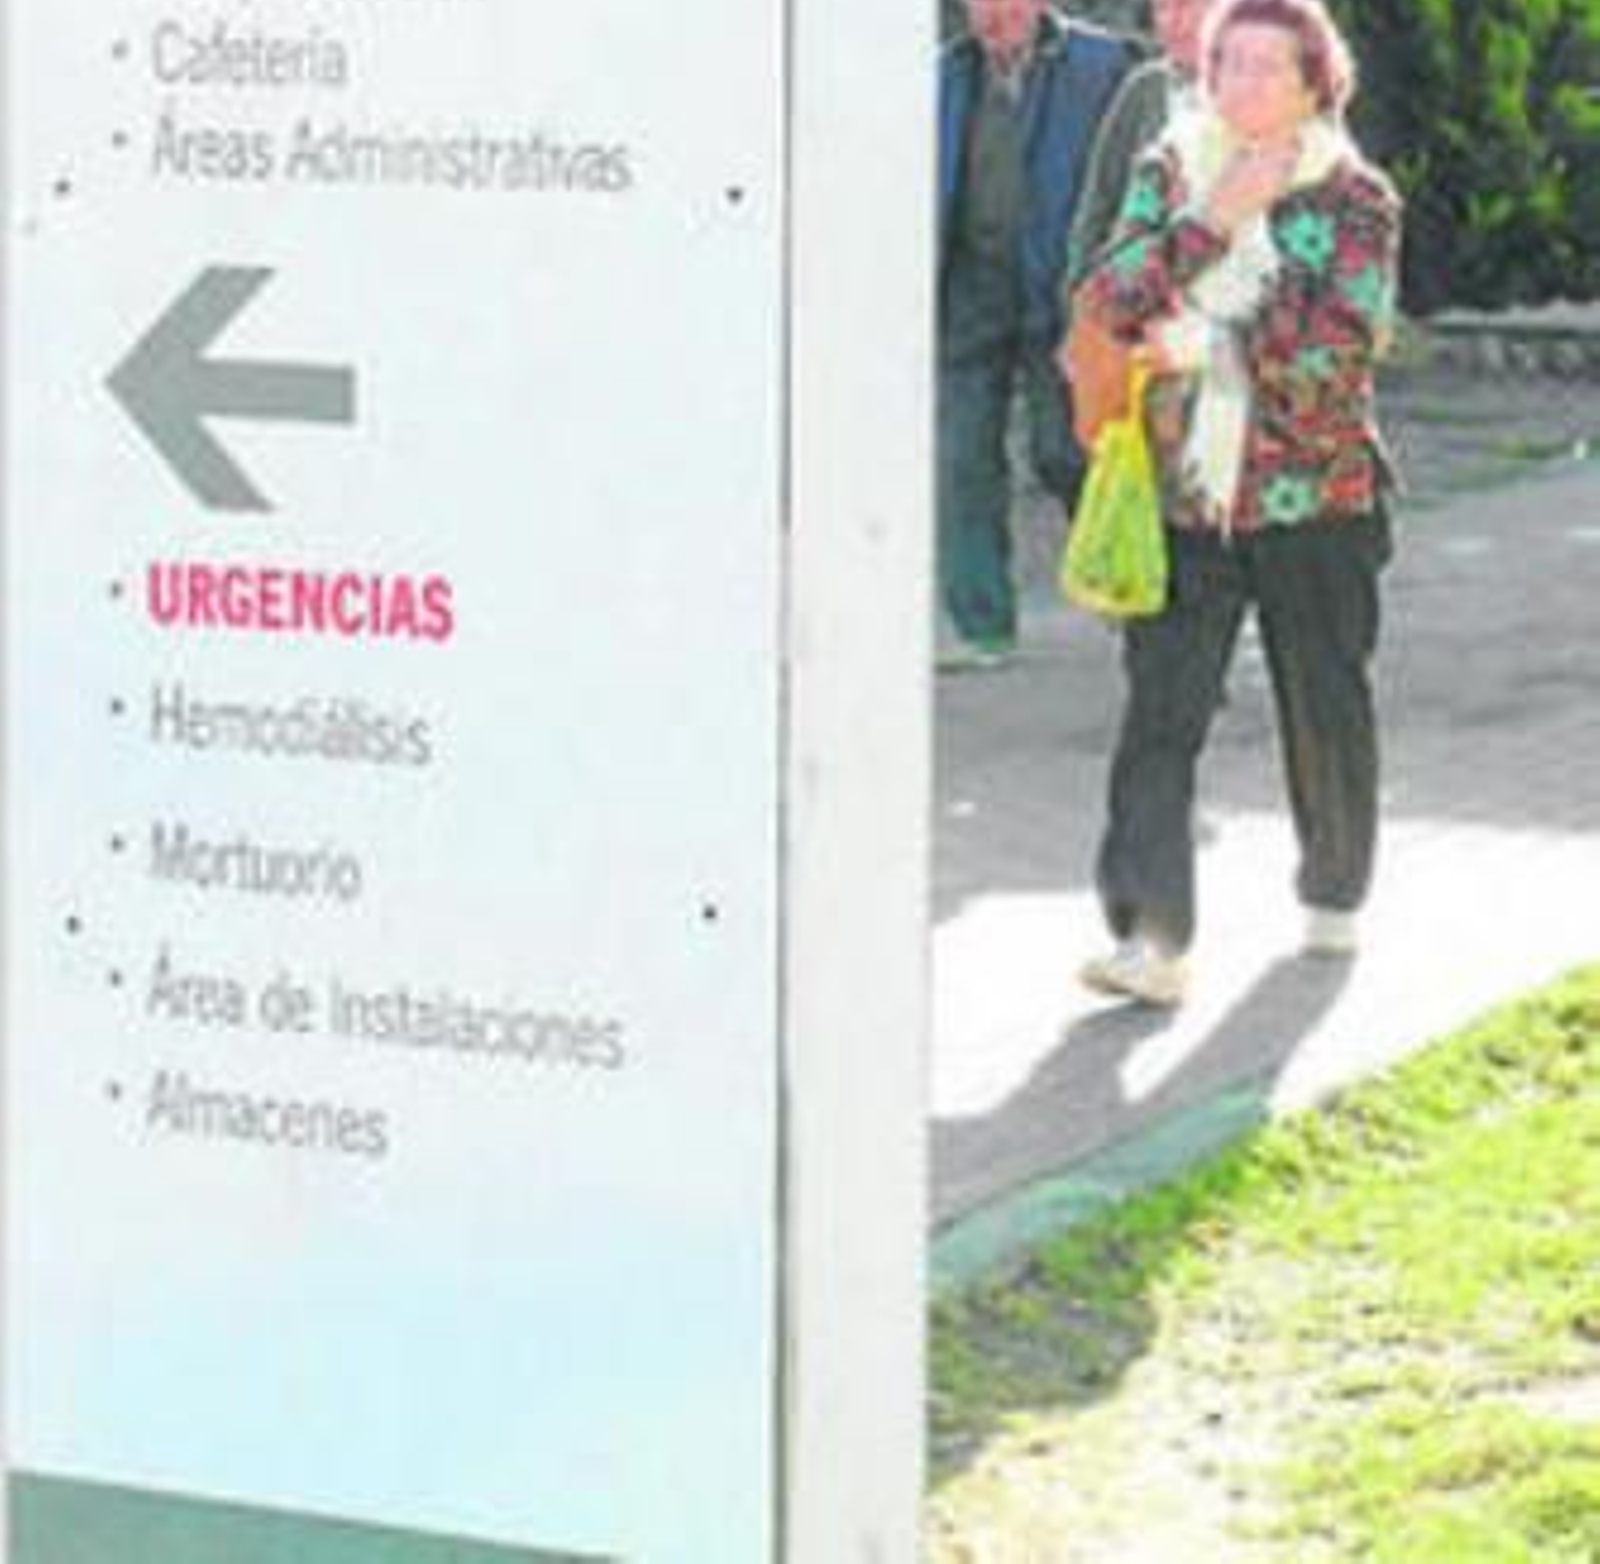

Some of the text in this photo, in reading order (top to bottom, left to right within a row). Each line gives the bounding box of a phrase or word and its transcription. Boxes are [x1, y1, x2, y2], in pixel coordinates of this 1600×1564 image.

[287, 117, 634, 192] Administrativas
[146, 562, 455, 641] URGENCIAS
[150, 822, 362, 899] Mortuorio
[146, 946, 625, 1070] Área de Instalaciones
[146, 1069, 390, 1158] Almacenes
